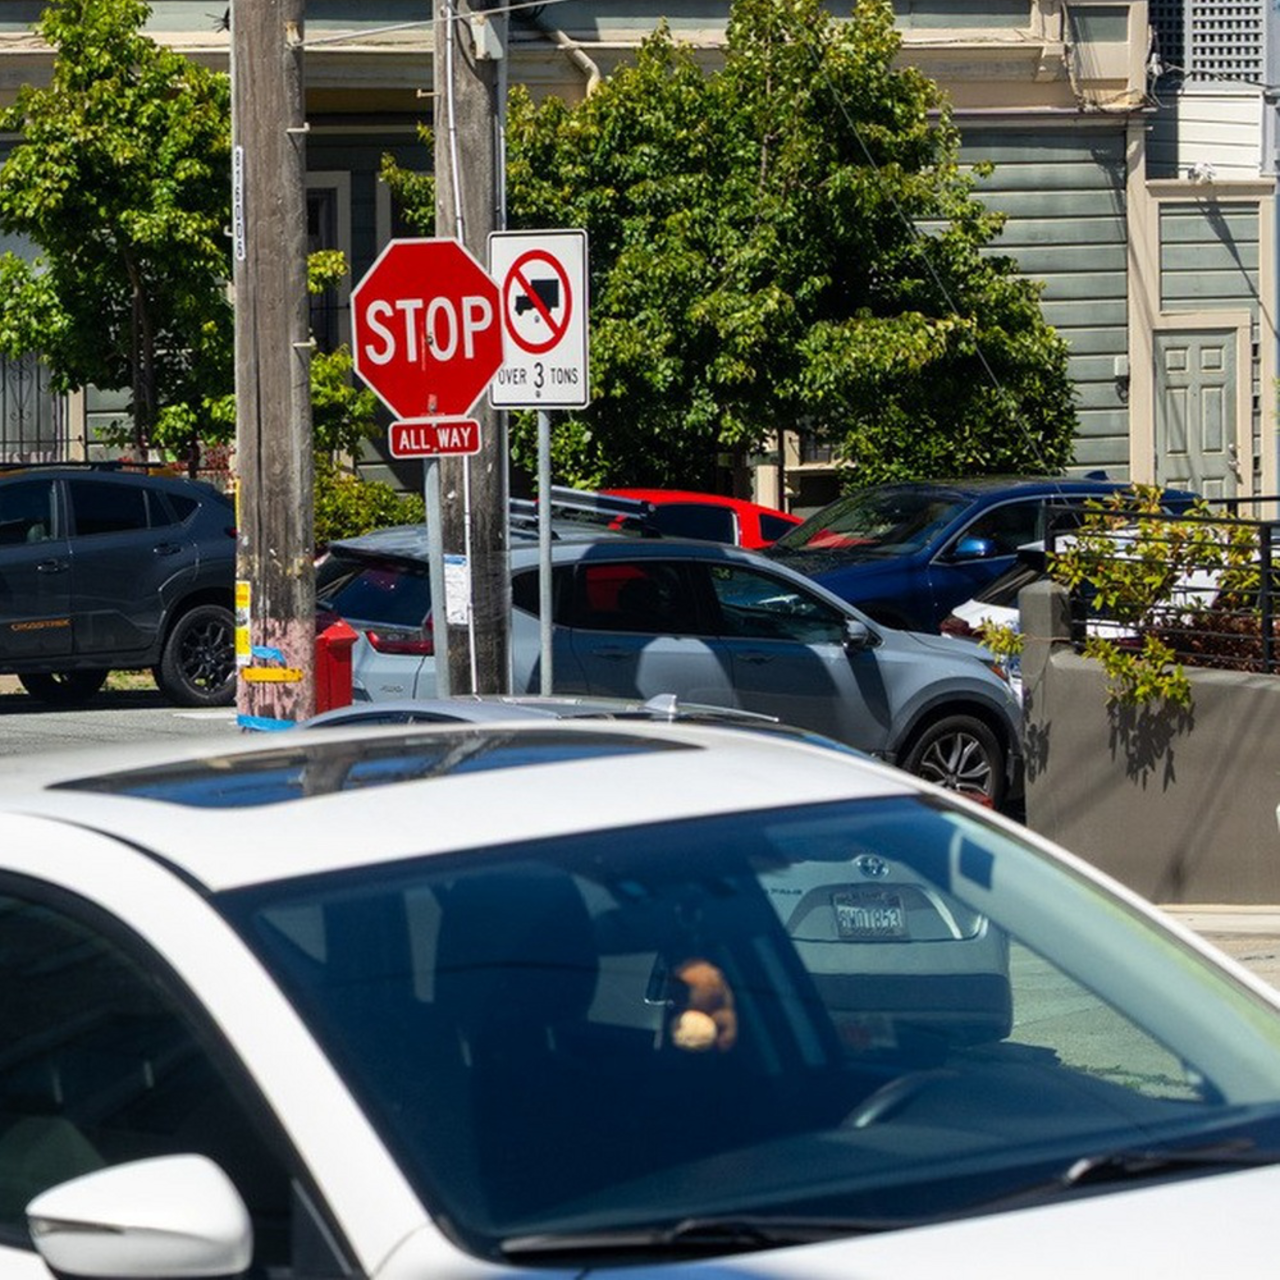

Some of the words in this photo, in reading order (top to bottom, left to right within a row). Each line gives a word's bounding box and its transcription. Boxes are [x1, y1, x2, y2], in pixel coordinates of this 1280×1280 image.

[365, 295, 493, 366] STOP
[498, 369, 527, 385] OVER
[533, 362, 544, 389] 3
[550, 368, 578, 385] TONS
[399, 429, 430, 451] ALL
[436, 427, 472, 449] WAY
